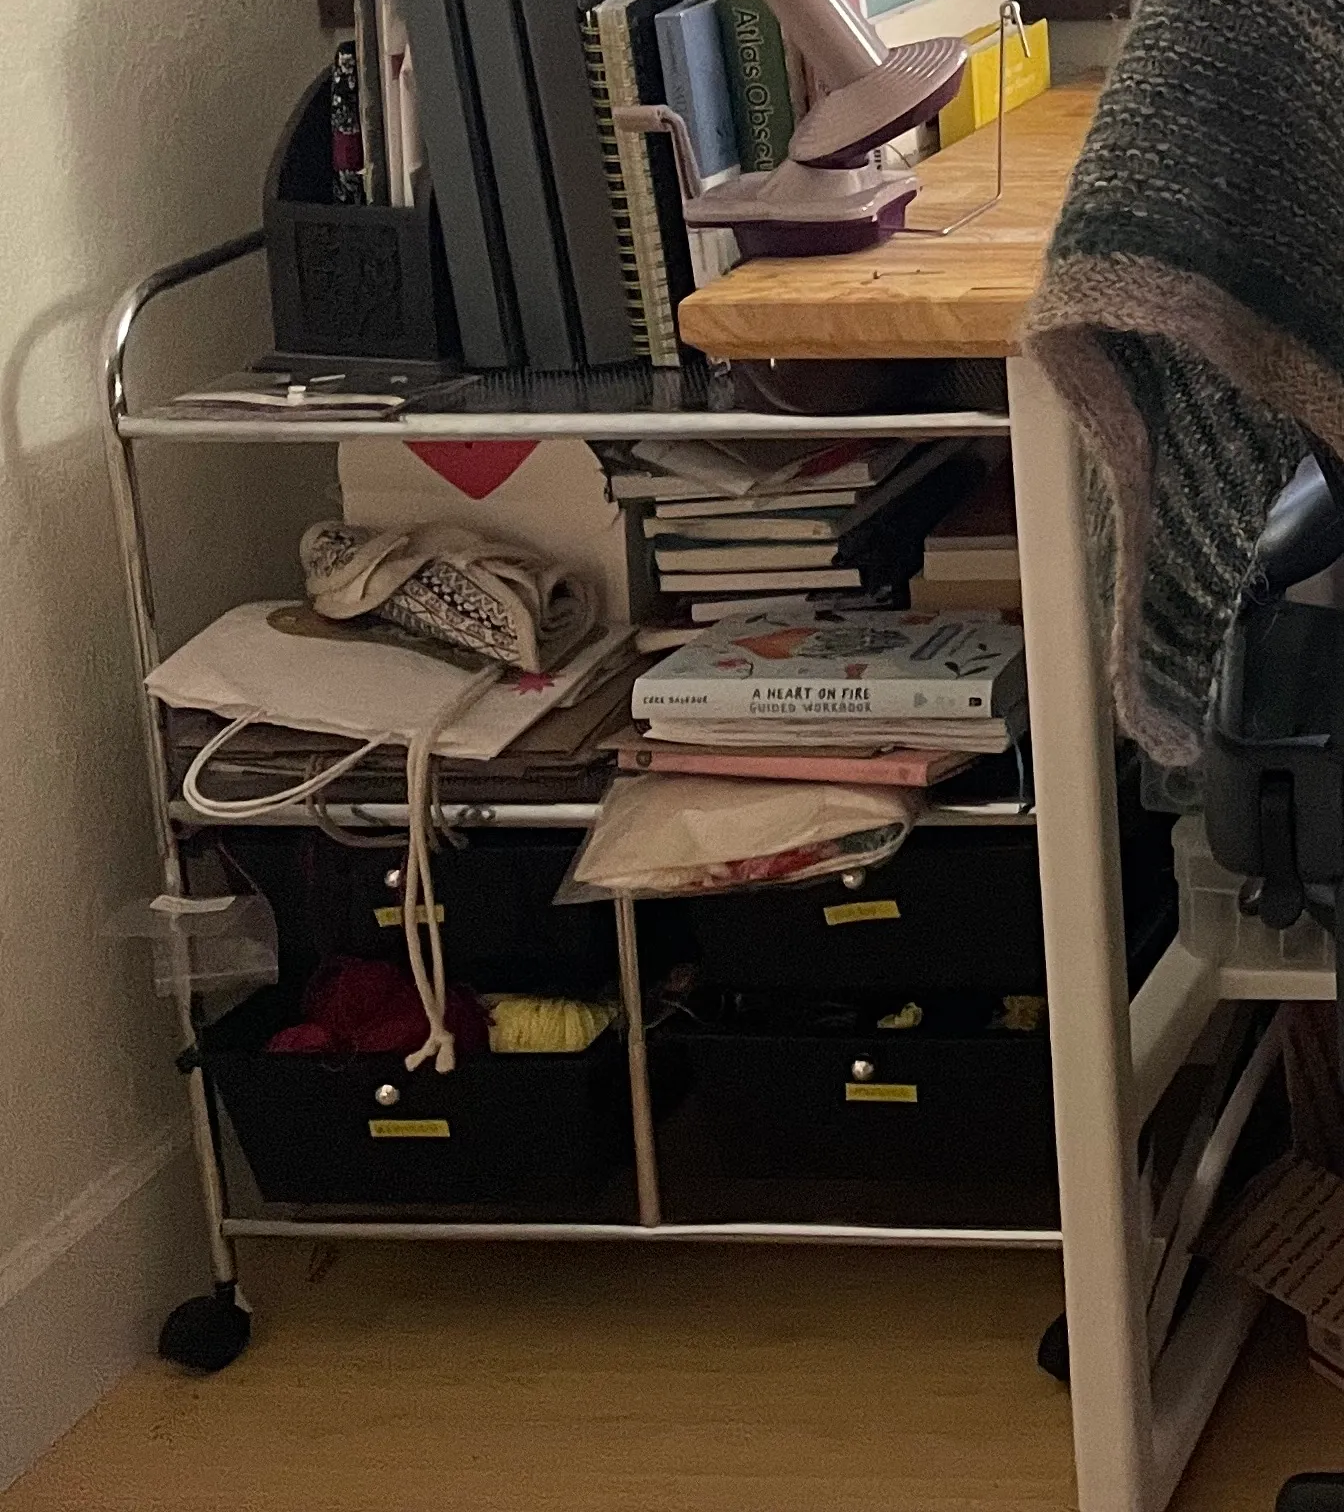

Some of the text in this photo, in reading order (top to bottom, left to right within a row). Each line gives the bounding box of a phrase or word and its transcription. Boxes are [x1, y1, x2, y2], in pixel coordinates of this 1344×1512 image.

[731, 6, 776, 172] Atlas Obscu
[752, 686, 870, 700] A HEART ON FIRE
[750, 701, 873, 714] GUIDED WORKBOOK
